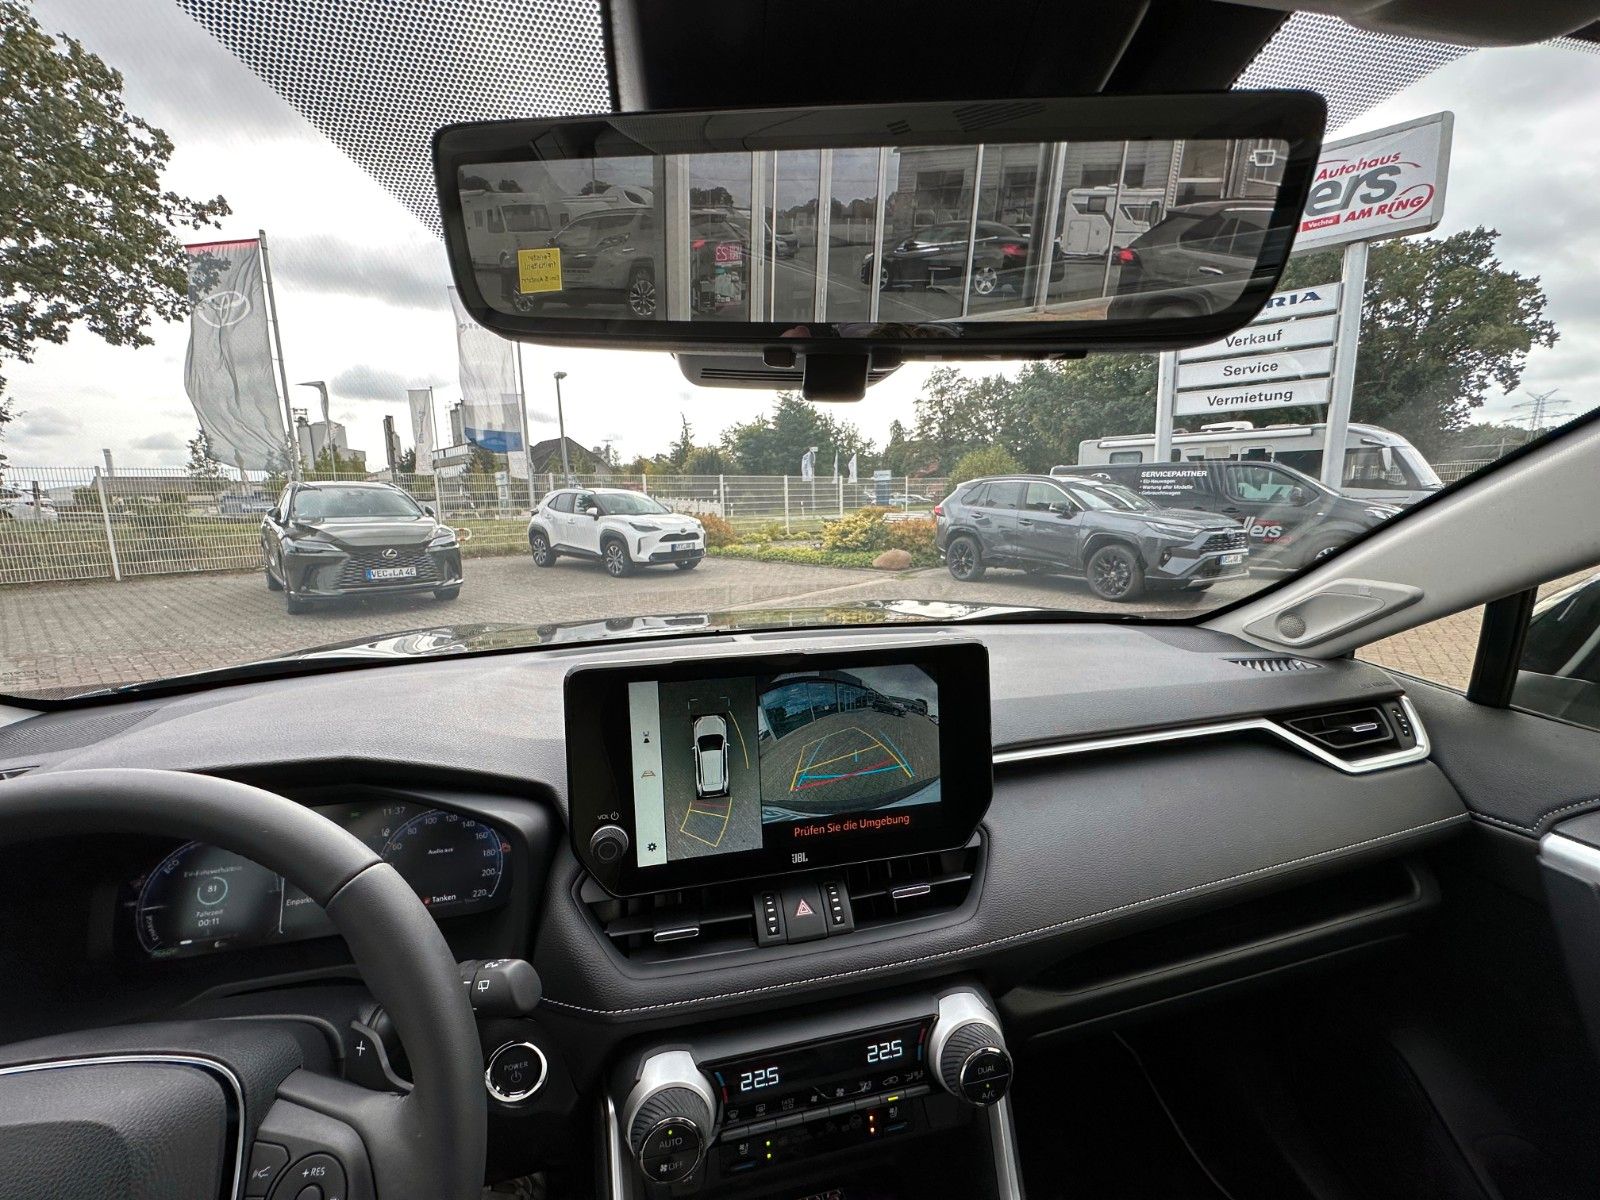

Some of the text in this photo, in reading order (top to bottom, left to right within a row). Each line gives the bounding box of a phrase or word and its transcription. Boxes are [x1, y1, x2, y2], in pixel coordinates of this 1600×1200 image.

[1315, 152, 1401, 182] Autohaus
[1343, 195, 1425, 223] AM RING
[1225, 329, 1283, 348] Verkauf
[1223, 362, 1279, 377] Service
[1207, 391, 1293, 407] Vermietung
[1141, 470, 1207, 478] SERVICEPARTNER
[425, 817, 438, 825] 100
[462, 820, 475, 829] 140
[794, 815, 910, 838] Prüfen Sie die Umgebung
[475, 831, 488, 840] 160
[483, 849, 496, 857] 180
[791, 852, 809, 864] JBL
[482, 867, 496, 877] 200
[472, 889, 487, 898] 220
[432, 894, 457, 904] Tanken
[868, 1040, 903, 1063] 22.5
[504, 1061, 530, 1071] POWER
[978, 1065, 995, 1074] DUAL
[740, 1066, 779, 1092] 22.5
[982, 1091, 995, 1100] A/C
[659, 1137, 683, 1149] AUTO
[669, 1161, 684, 1170] OFF
